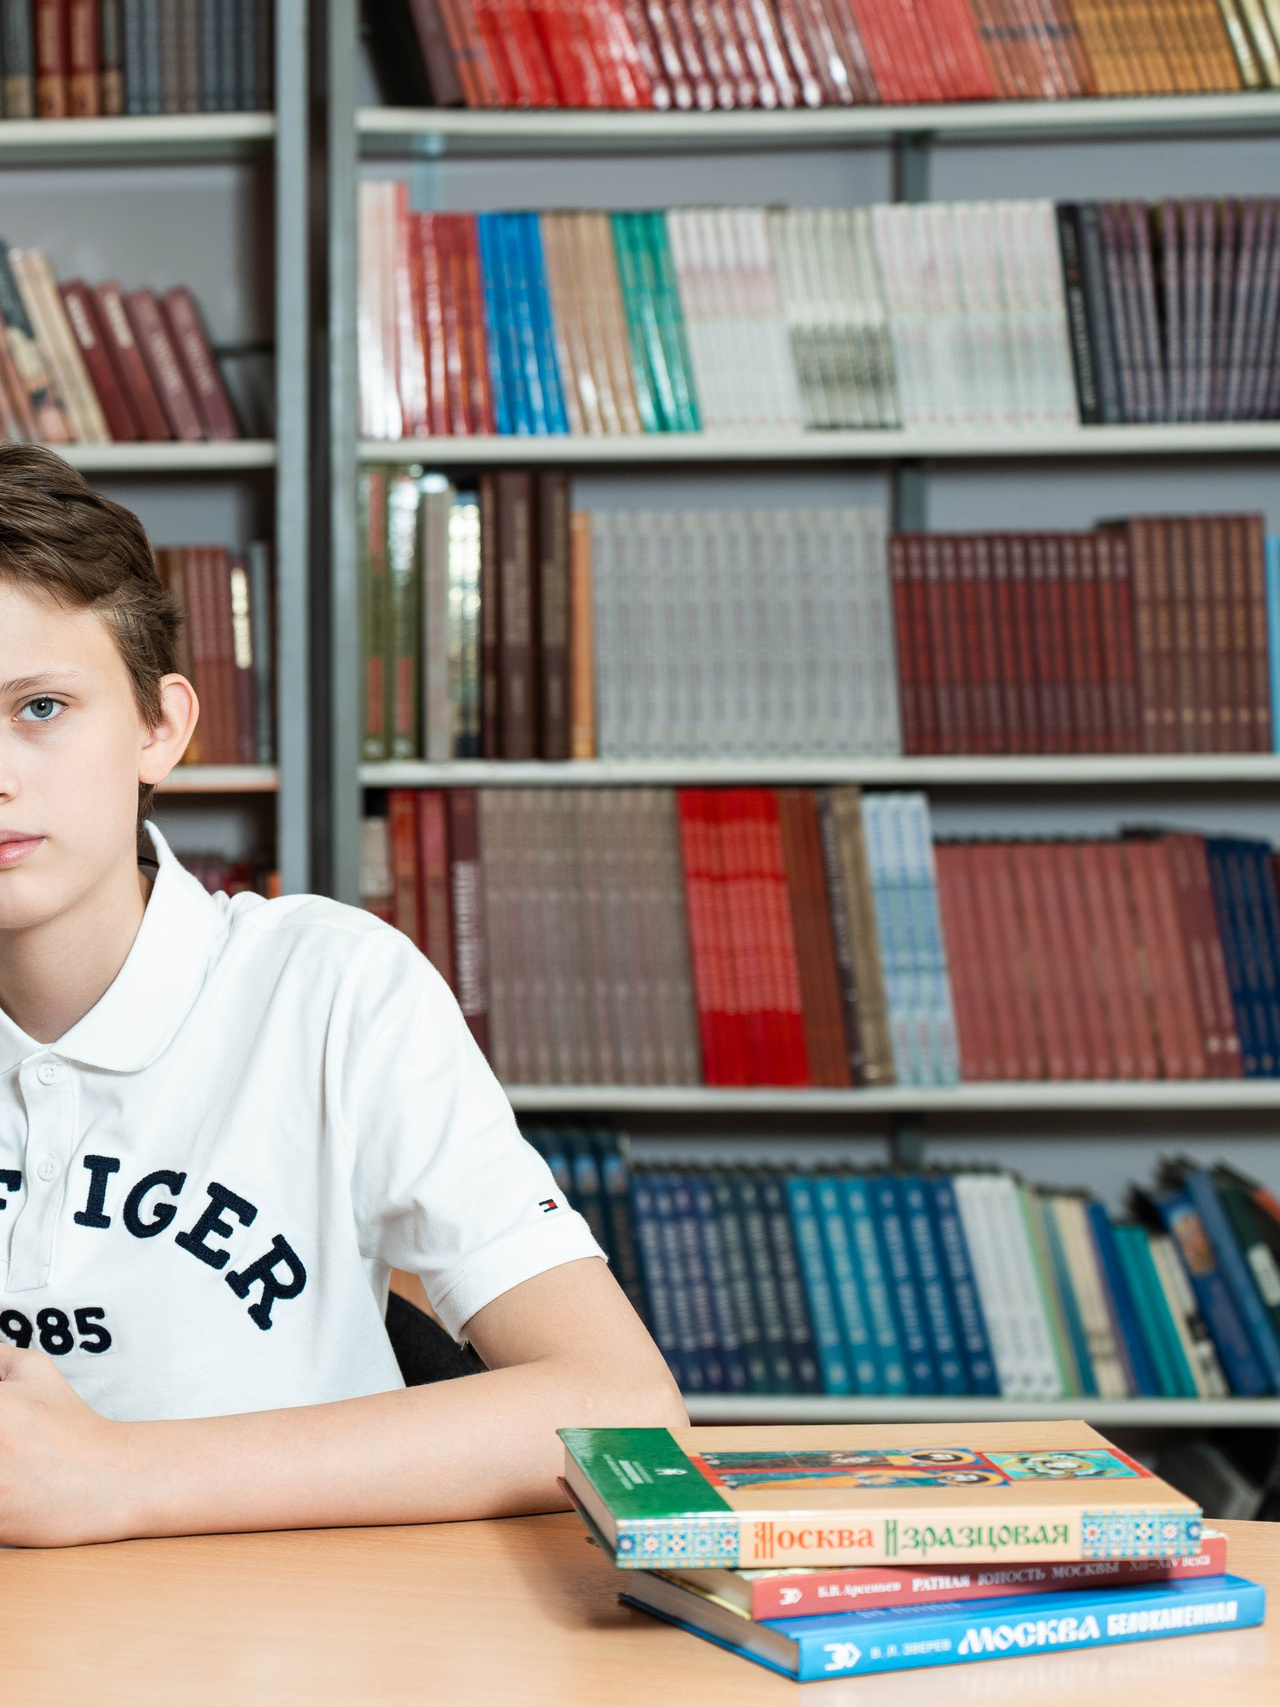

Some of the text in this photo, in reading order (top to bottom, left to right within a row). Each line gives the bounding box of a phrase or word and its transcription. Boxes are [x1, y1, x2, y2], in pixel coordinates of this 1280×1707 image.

[753, 1519, 1069, 1560] Москва Изразцовая
[912, 1575, 970, 1592] РАТНАЯ
[977, 1567, 1045, 1586] ЮНОСТЬ
[1051, 1562, 1120, 1580] МОСКВЫ
[902, 1638, 952, 1656] ЗВЕРЕВ
[957, 1615, 1101, 1655] МОСКВА
[1107, 1600, 1239, 1637] БЕЛОКАМЕННАЯ
